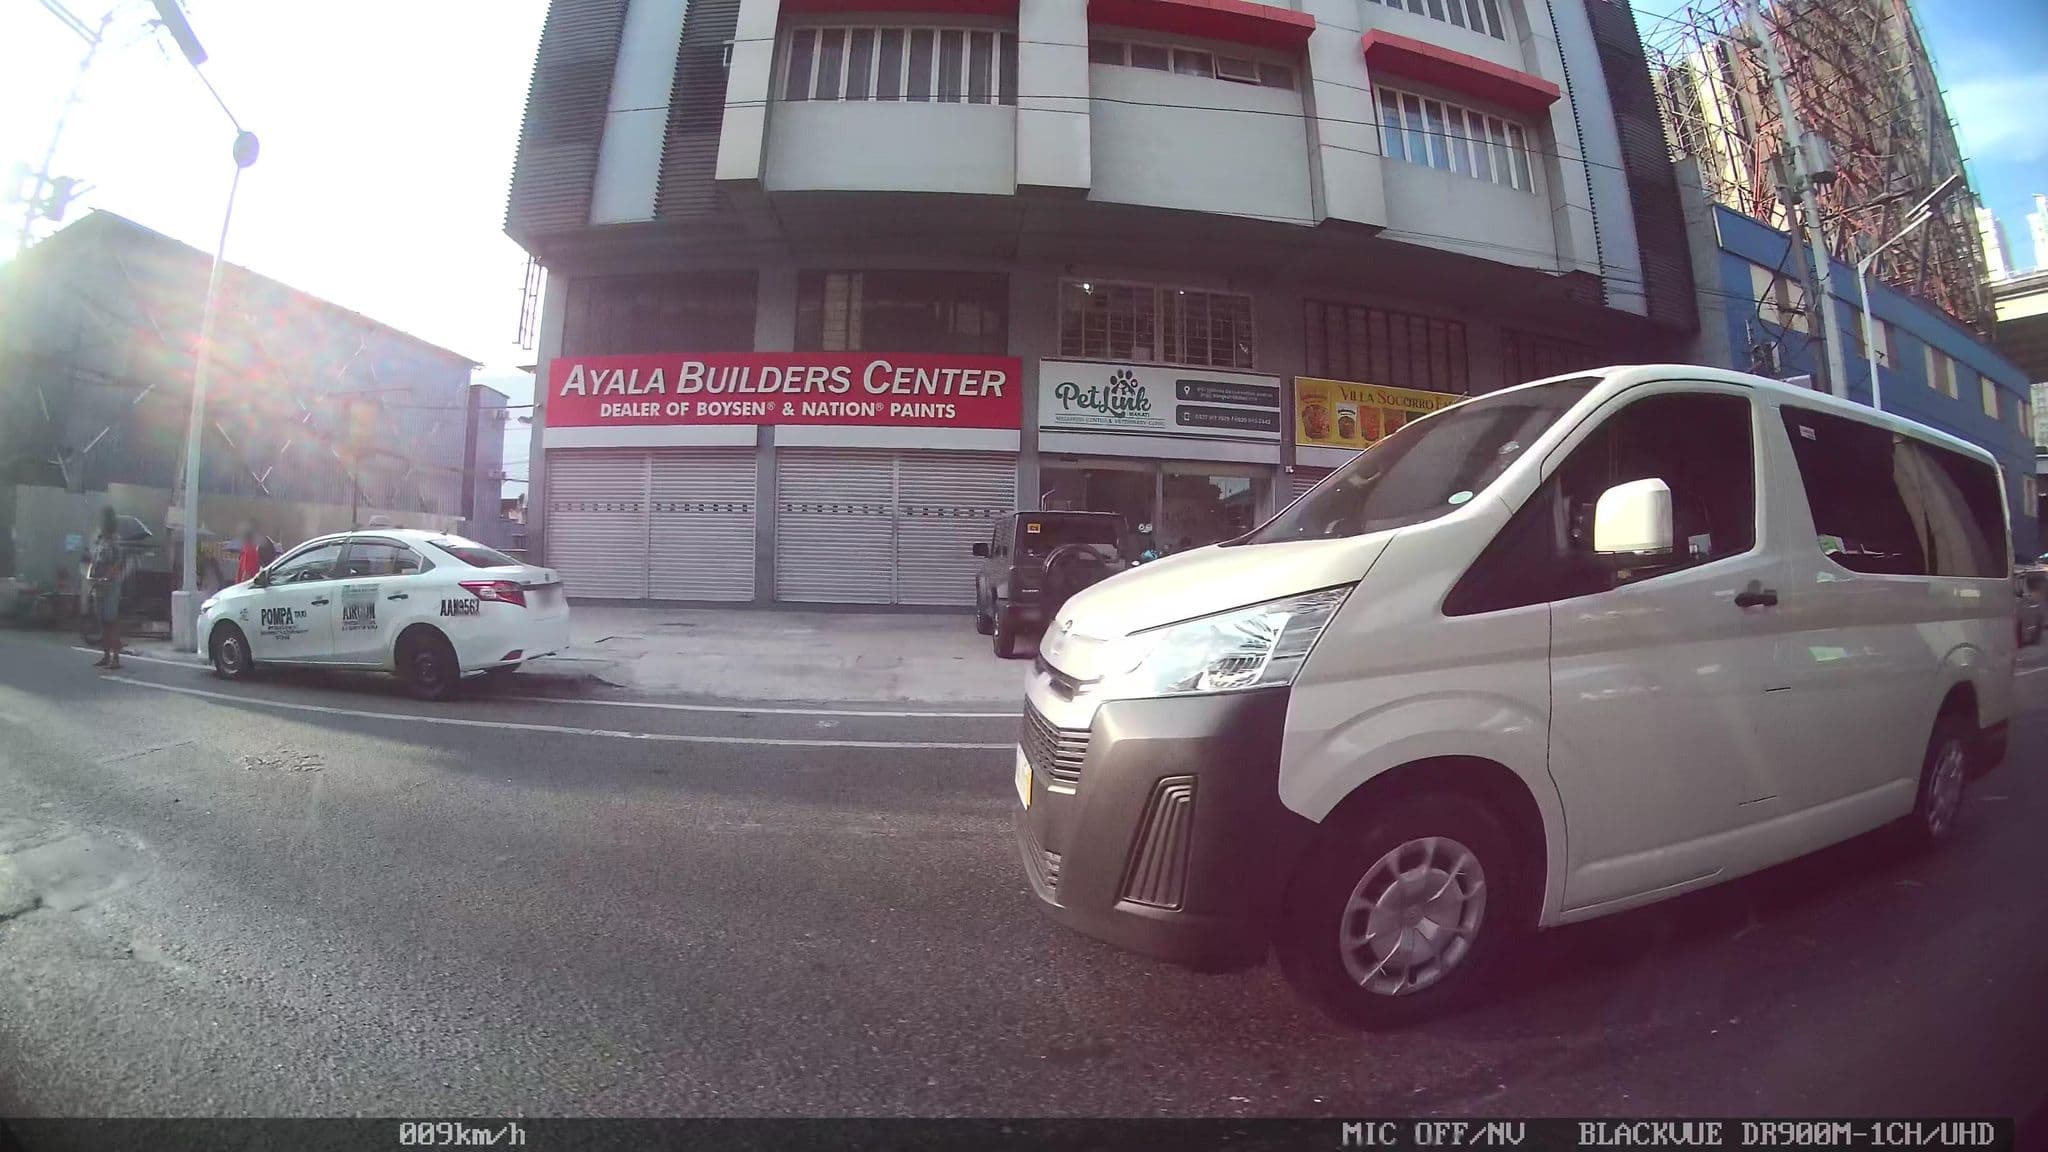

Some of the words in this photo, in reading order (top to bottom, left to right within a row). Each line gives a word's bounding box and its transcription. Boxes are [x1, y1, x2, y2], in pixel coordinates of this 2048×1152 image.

[560, 364, 666, 397] AYALA
[676, 361, 852, 395] BUILDERS
[863, 360, 1007, 397] CENTER
[600, 402, 660, 418] DEALER
[666, 402, 690, 417] OF
[782, 402, 796, 417] &
[890, 403, 956, 419] PAINTS
[1055, 382, 1152, 418] PetLink
[1338, 386, 1375, 404] VILLA
[1377, 390, 1435, 411] SOCORRO
[261, 607, 294, 626] POMPA
